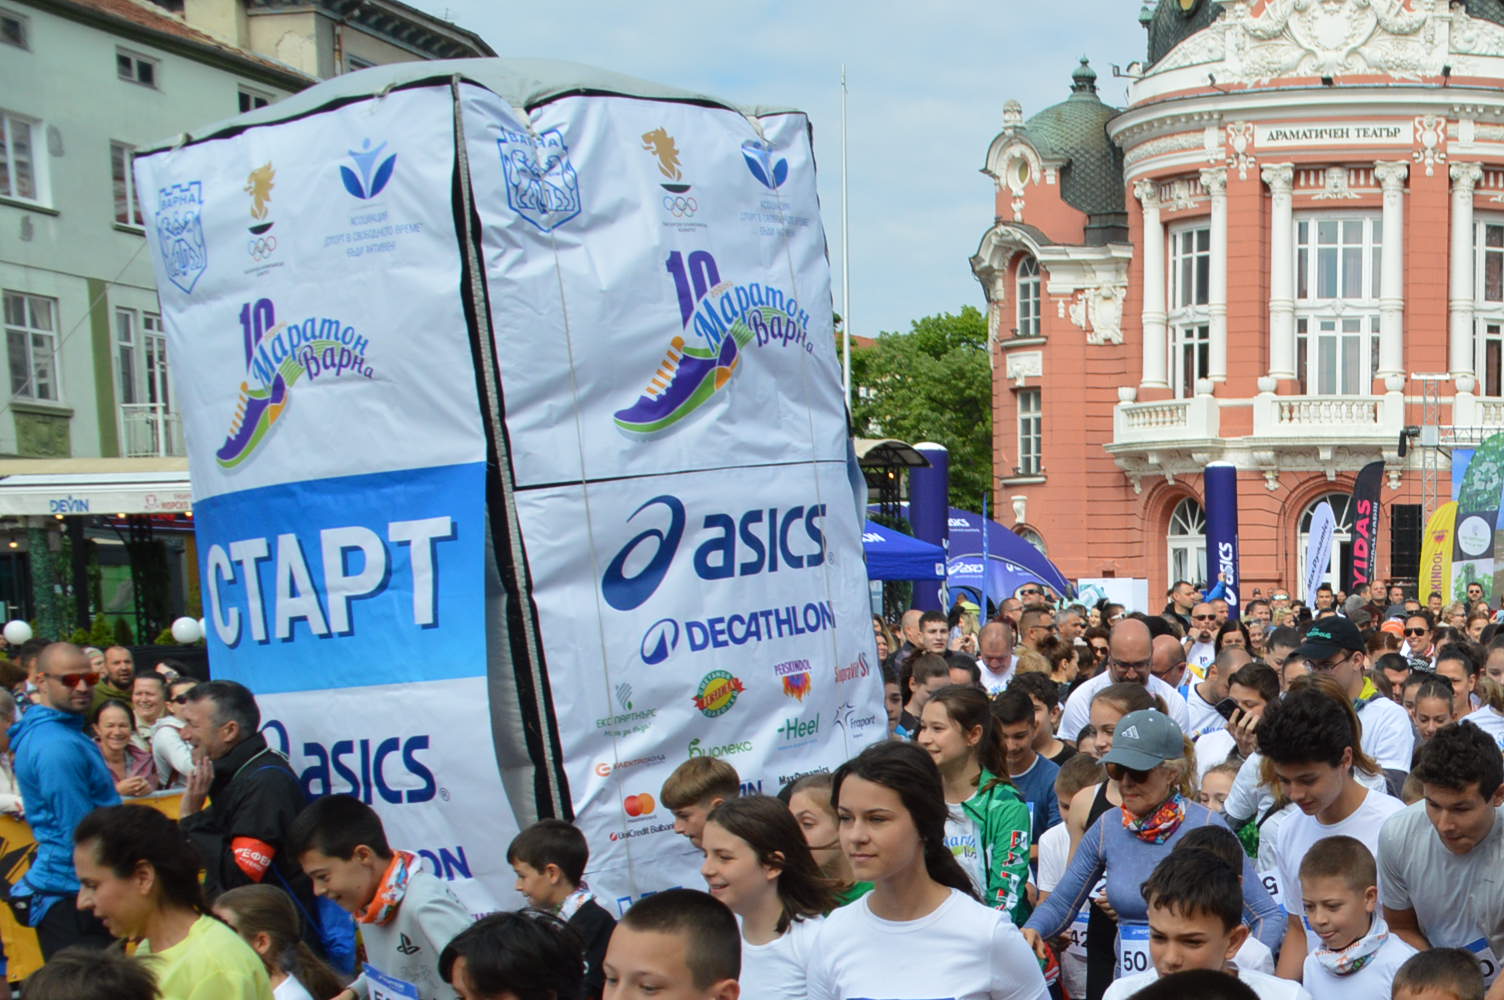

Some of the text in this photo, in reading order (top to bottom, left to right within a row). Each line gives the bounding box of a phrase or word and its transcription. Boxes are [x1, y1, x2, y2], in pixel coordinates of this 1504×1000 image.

[1267, 127, 1401, 141] ДРАМАТИЧЕН ТЕАТЪР
[253, 317, 369, 392] Маратон
[298, 344, 374, 381] Варна
[50, 499, 89, 512] DEVIN
[207, 516, 455, 648] СТАРТ
[686, 601, 836, 652] DECATHLON
[774, 659, 812, 676] PERSKINDOL
[850, 714, 876, 730] Fraport
